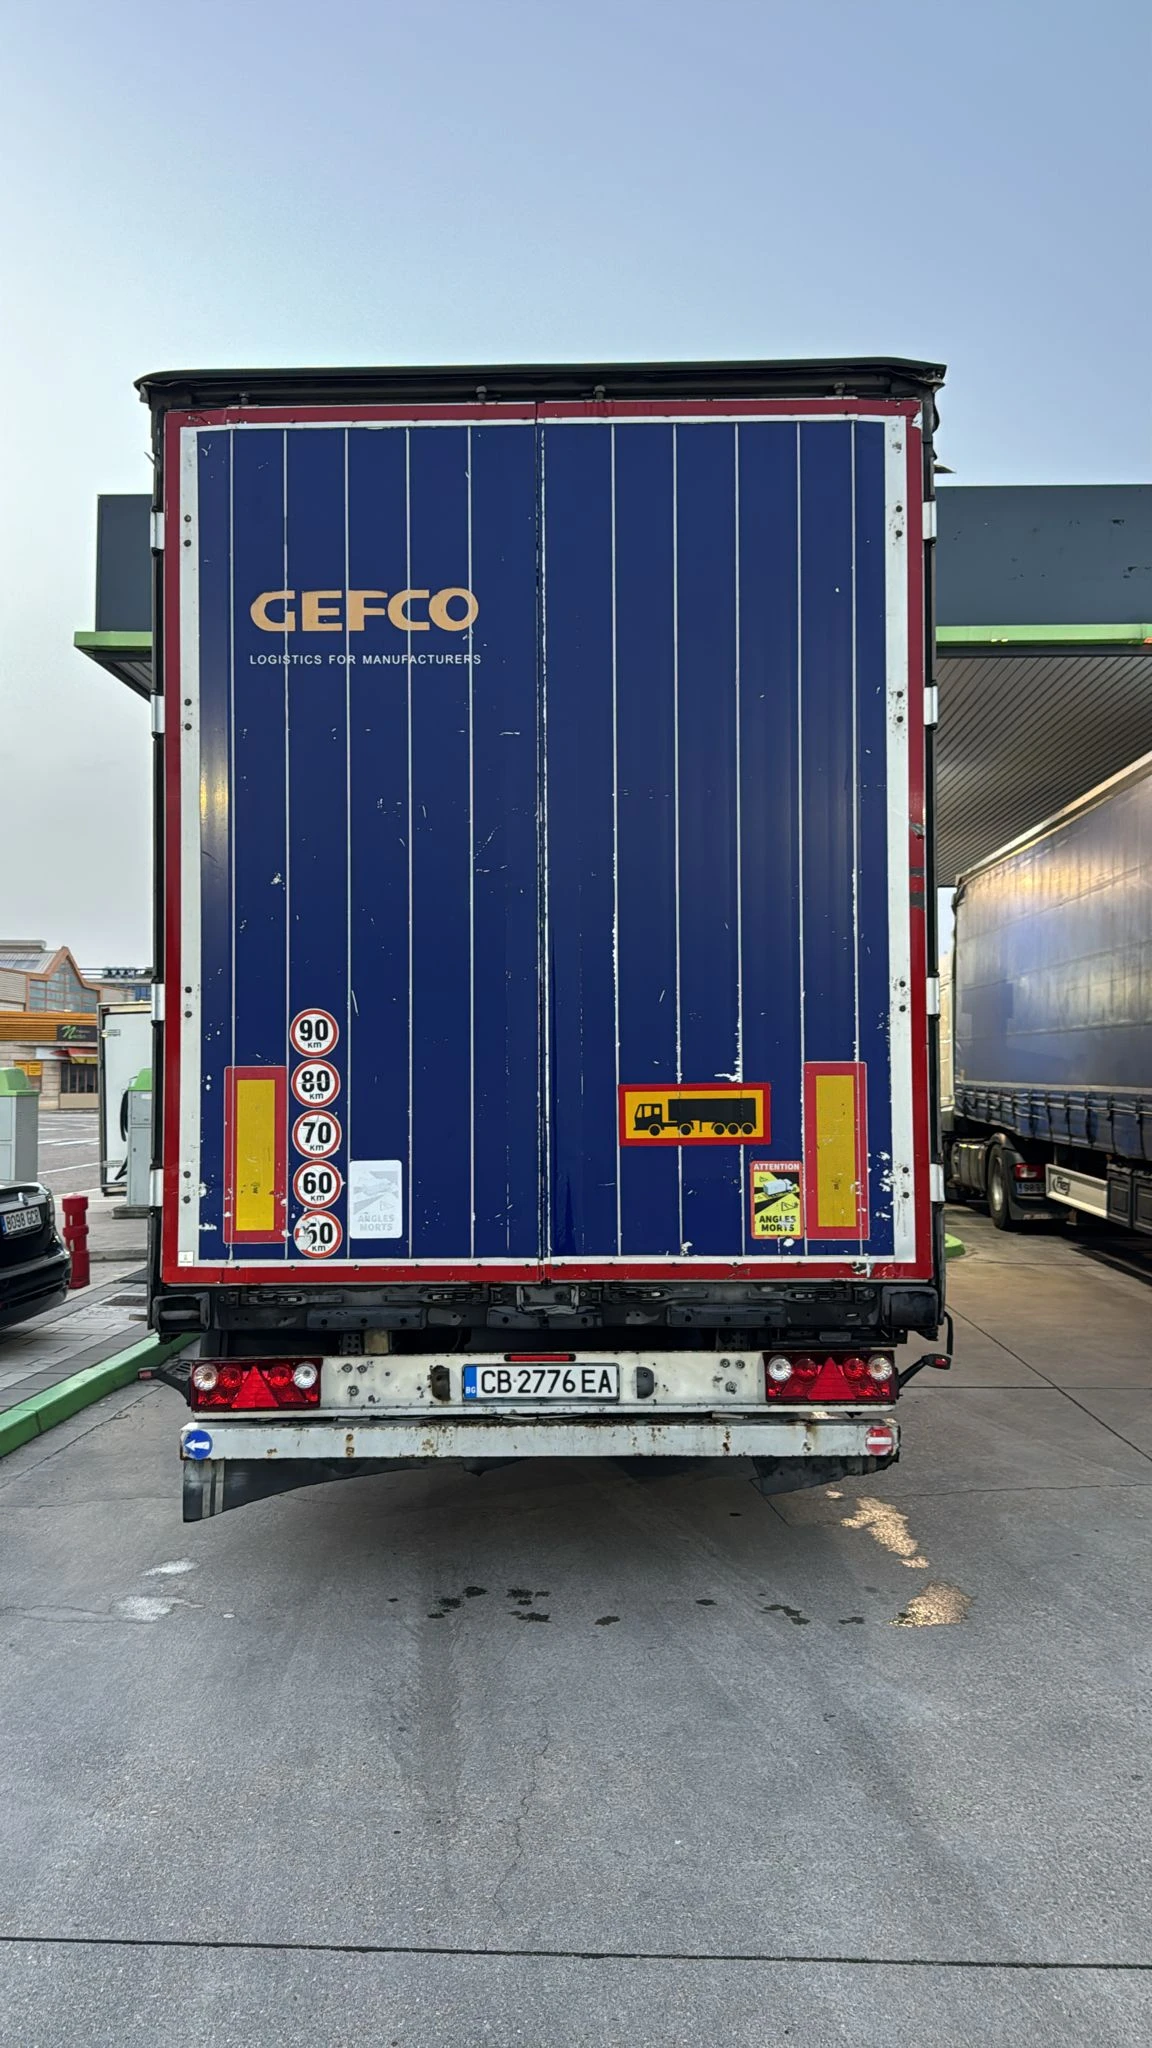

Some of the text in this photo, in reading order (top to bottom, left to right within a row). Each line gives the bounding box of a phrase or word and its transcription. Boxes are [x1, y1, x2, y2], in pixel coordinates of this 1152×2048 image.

[250, 587, 479, 631] GEFCO
[250, 654, 482, 665] LOGISTICS FOR MANUFACTURERS
[299, 1019, 328, 1041] 90
[301, 1070, 330, 1093] 80
[302, 1122, 332, 1144] 70
[753, 1163, 800, 1171] ATTENTION
[303, 1172, 332, 1194] 60
[359, 1214, 395, 1223] ANGLES
[758, 1215, 797, 1224] ANGLES
[360, 1223, 393, 1232] MORTS
[761, 1224, 795, 1232] MORTS
[465, 1386, 476, 1394] BG
[517, 1369, 576, 1393] 2776
[581, 1369, 612, 1394] EA
